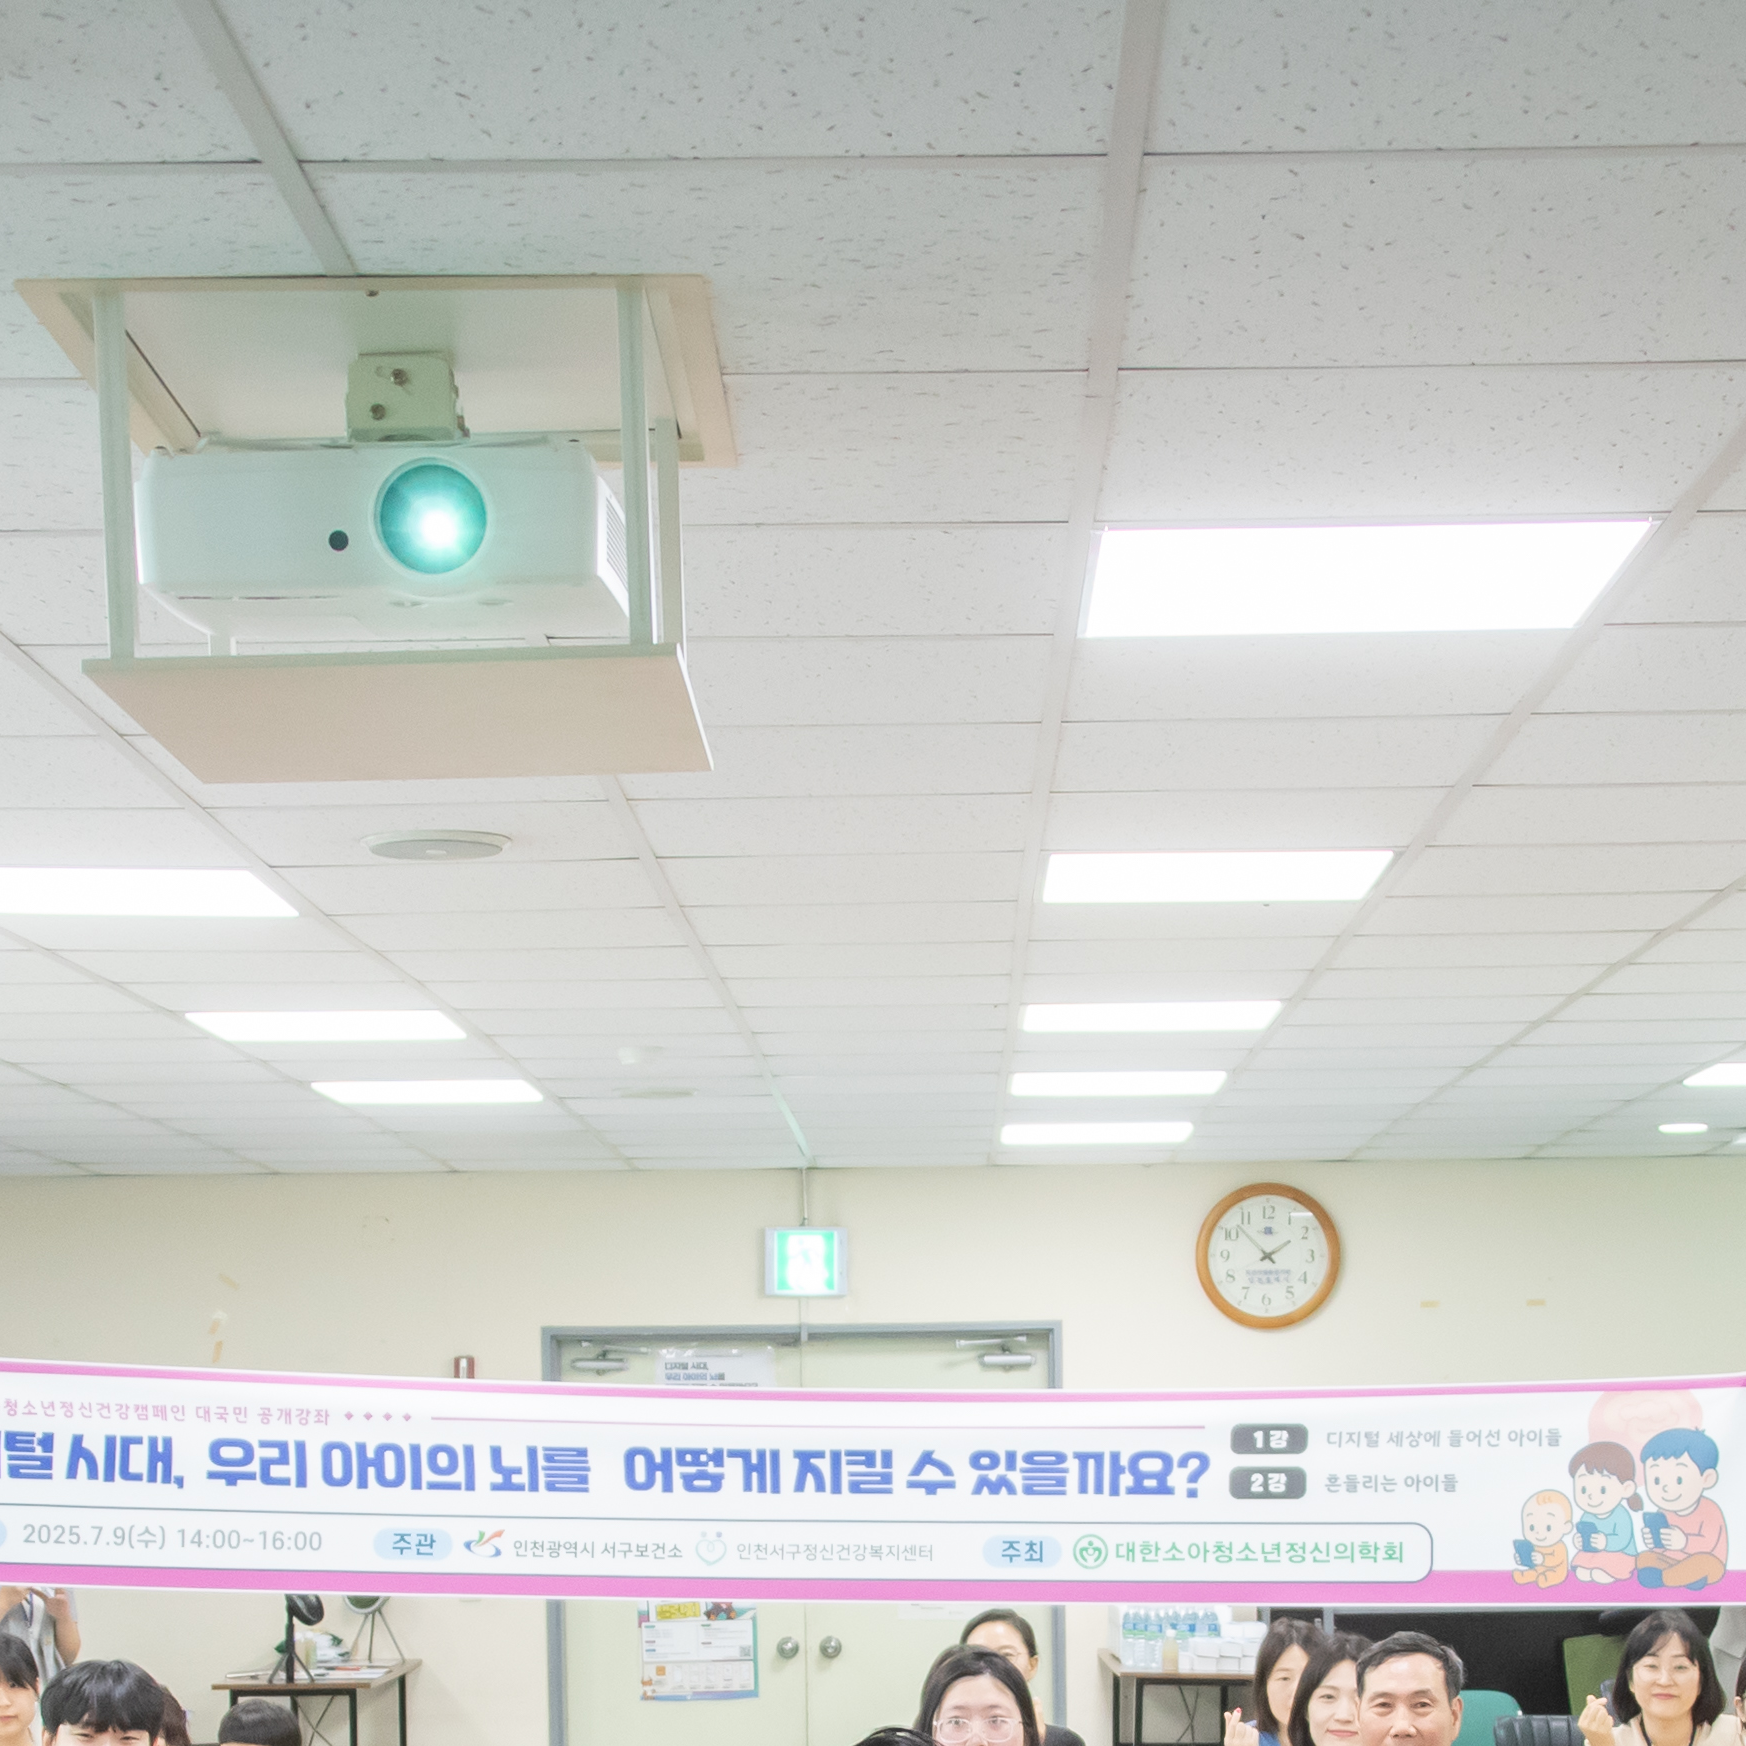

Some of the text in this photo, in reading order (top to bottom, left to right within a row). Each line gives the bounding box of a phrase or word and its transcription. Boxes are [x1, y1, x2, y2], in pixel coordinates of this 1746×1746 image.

[1241, 1211, 1251, 1225] 11
[1262, 1205, 1275, 1219] 12
[1224, 1227, 1239, 1241] 10
[1301, 1226, 1309, 1240] 2
[1220, 1250, 1230, 1263] 9
[1306, 1249, 1315, 1264] 3
[1225, 1269, 1236, 1283] 8
[1298, 1271, 1308, 1285] 4
[1242, 1286, 1250, 1300] 7
[1261, 1293, 1271, 1306] 6
[1285, 1286, 1295, 1300] 5
[196, 1406, 247, 1423] 대국민
[258, 1407, 330, 1426] 공개강좌
[1327, 1428, 1562, 1448] 디지털 세상에 들어선 아이들
[65, 1434, 184, 1489] 시대,
[206, 1438, 307, 1488] 우리
[321, 1441, 475, 1491] 아이의
[490, 1445, 591, 1493] 뇌를
[624, 1447, 780, 1494] 어떻게
[793, 1449, 893, 1494] 지킬
[906, 1450, 956, 1495] 수
[969, 1450, 1210, 1498] 있을까요?
[1325, 1474, 1458, 1493] 흔들리는 아이들
[23, 1524, 322, 1551] 2025.7.9(수) 14:00~16:00
[392, 1533, 436, 1556] 주관
[513, 1540, 682, 1559] 인천광역시 서구보건소
[737, 1544, 932, 1561] 인천서구정신건강복지센터
[1001, 1540, 1043, 1563] 주최
[1116, 1541, 1403, 1564] 대한소아청소년정신의학회
